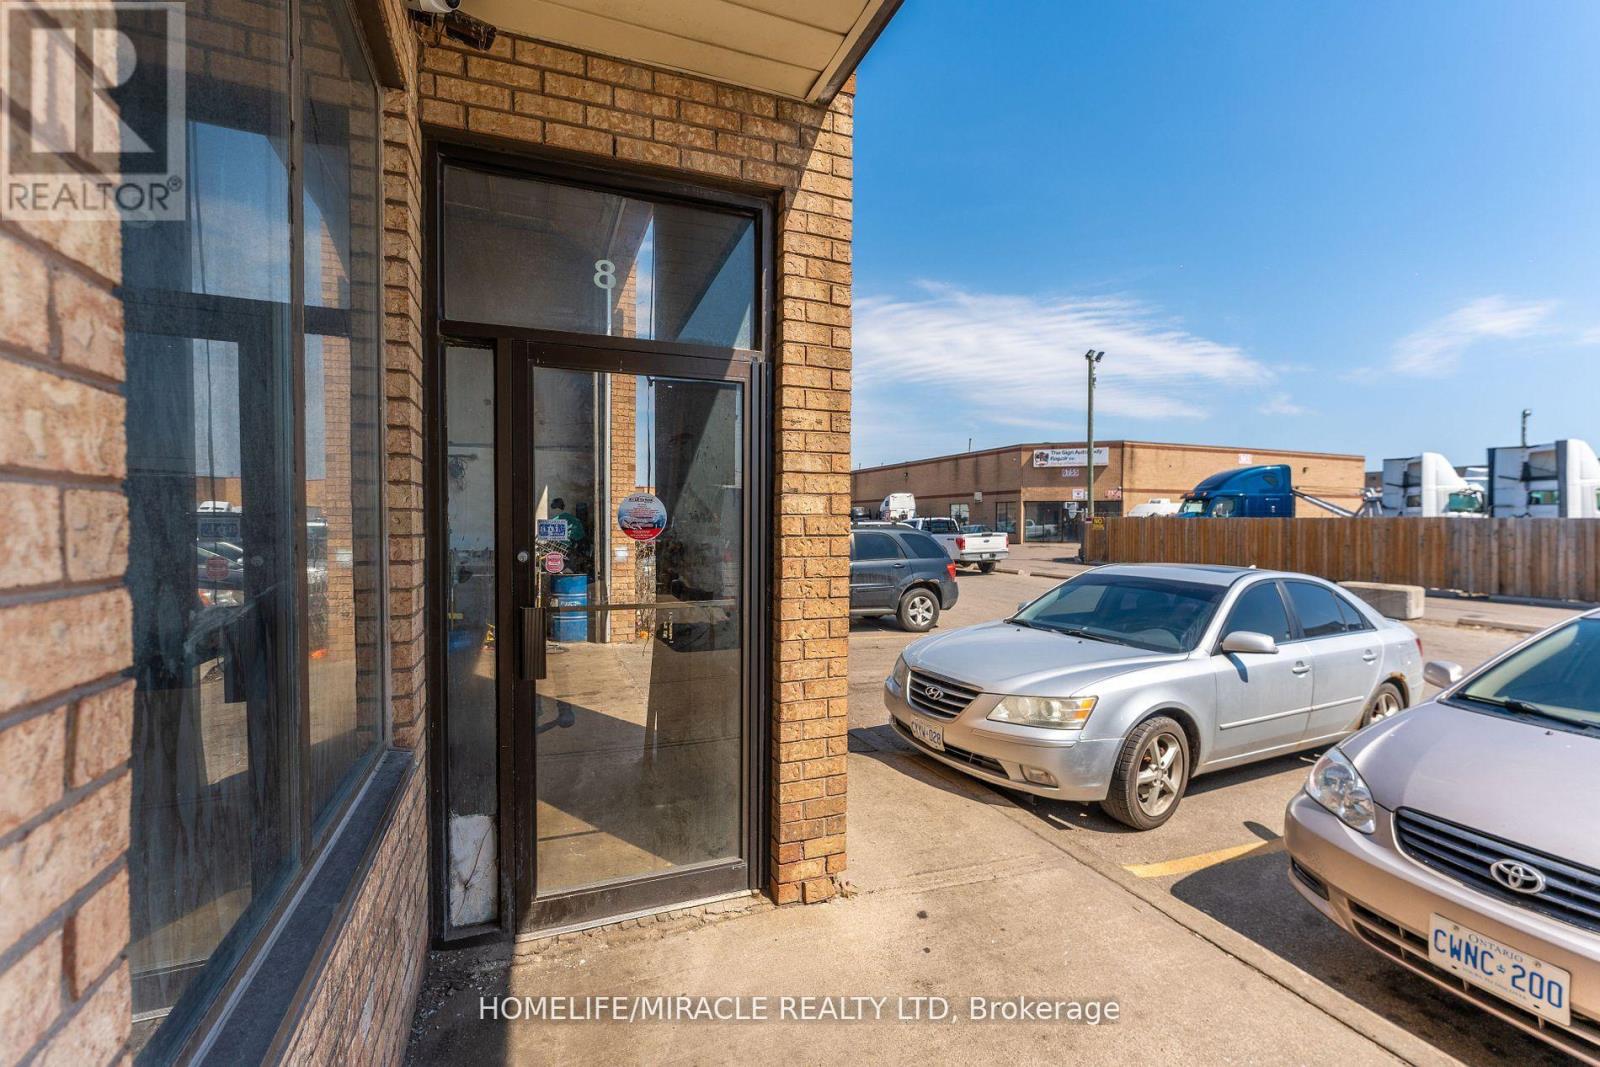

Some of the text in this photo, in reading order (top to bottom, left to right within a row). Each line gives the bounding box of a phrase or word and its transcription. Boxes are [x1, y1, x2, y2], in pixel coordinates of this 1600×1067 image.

[593, 259, 617, 289] 8
[1468, 933, 1524, 963] ONTARIO
[1433, 928, 1494, 976] CWNC
[1511, 964, 1563, 1009] 200
